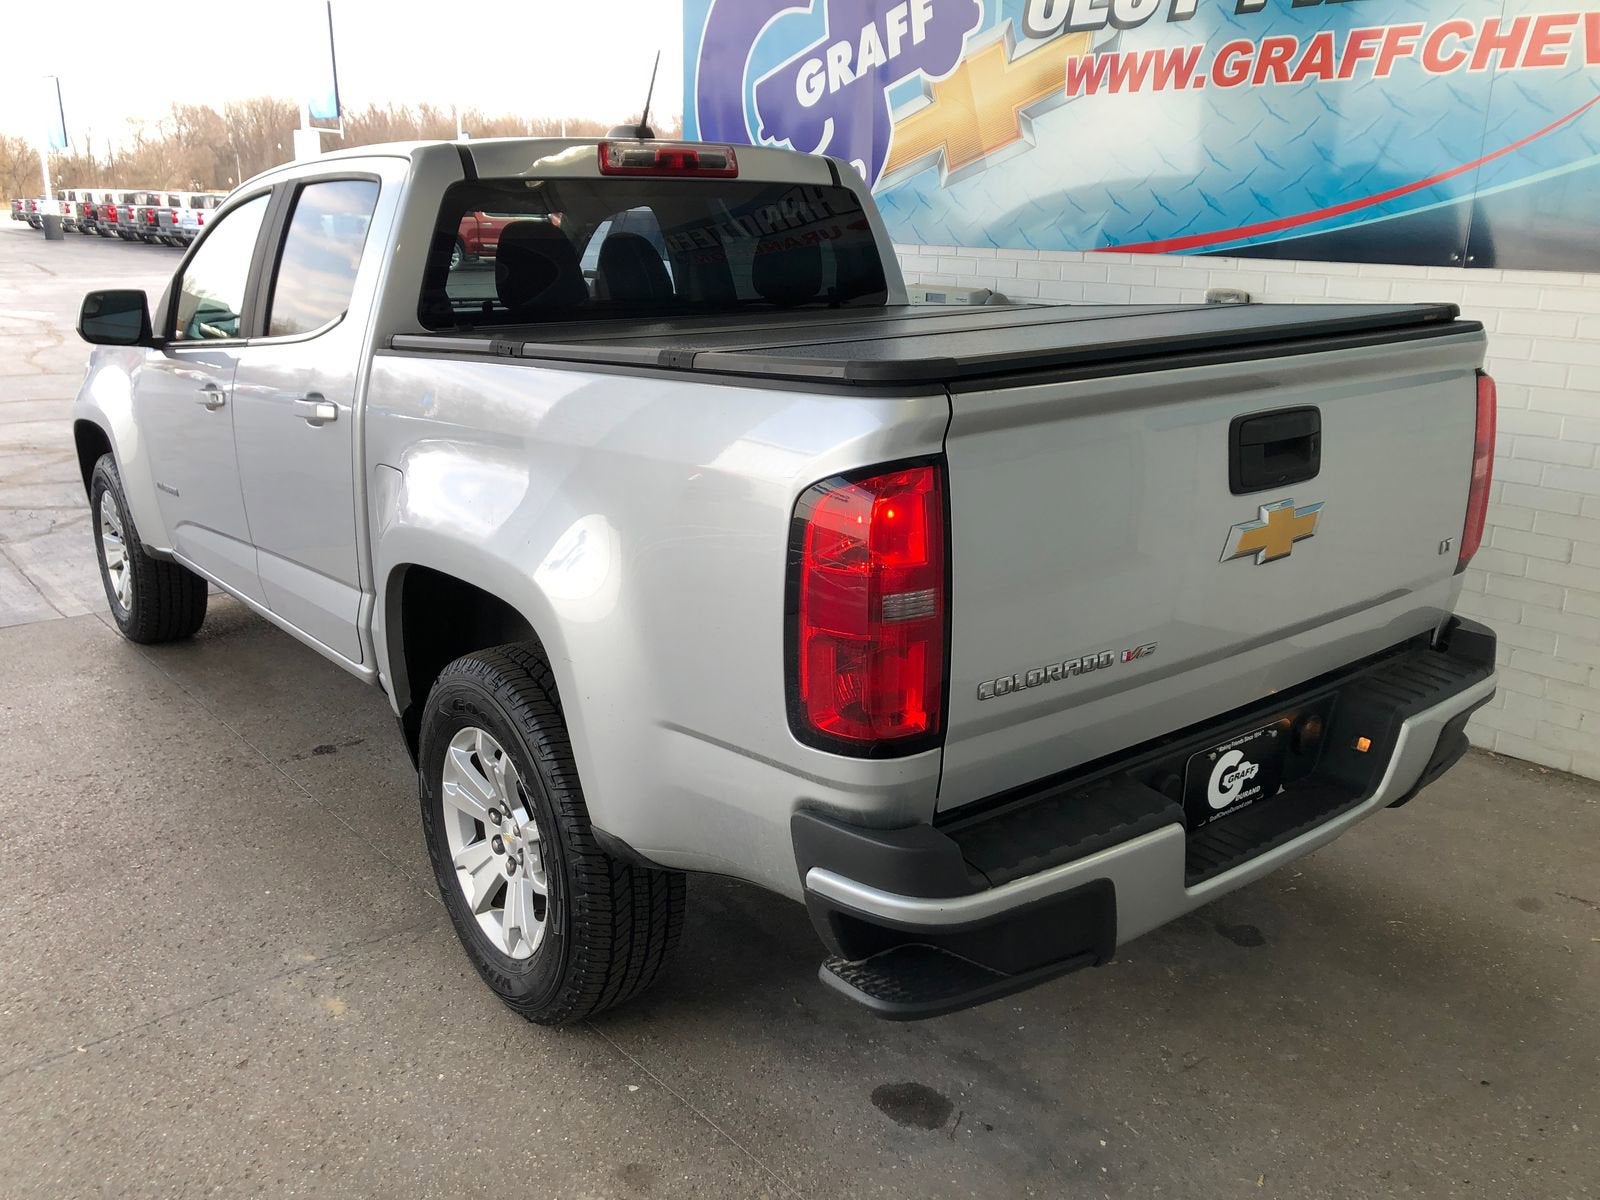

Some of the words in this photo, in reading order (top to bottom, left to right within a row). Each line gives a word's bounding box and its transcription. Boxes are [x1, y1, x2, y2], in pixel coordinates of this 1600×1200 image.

[796, 0, 934, 108] GRAFF
[977, 649, 1116, 701] COLORADO
[1227, 765, 1257, 784] GRAFF
[1235, 785, 1261, 802] DURAND
